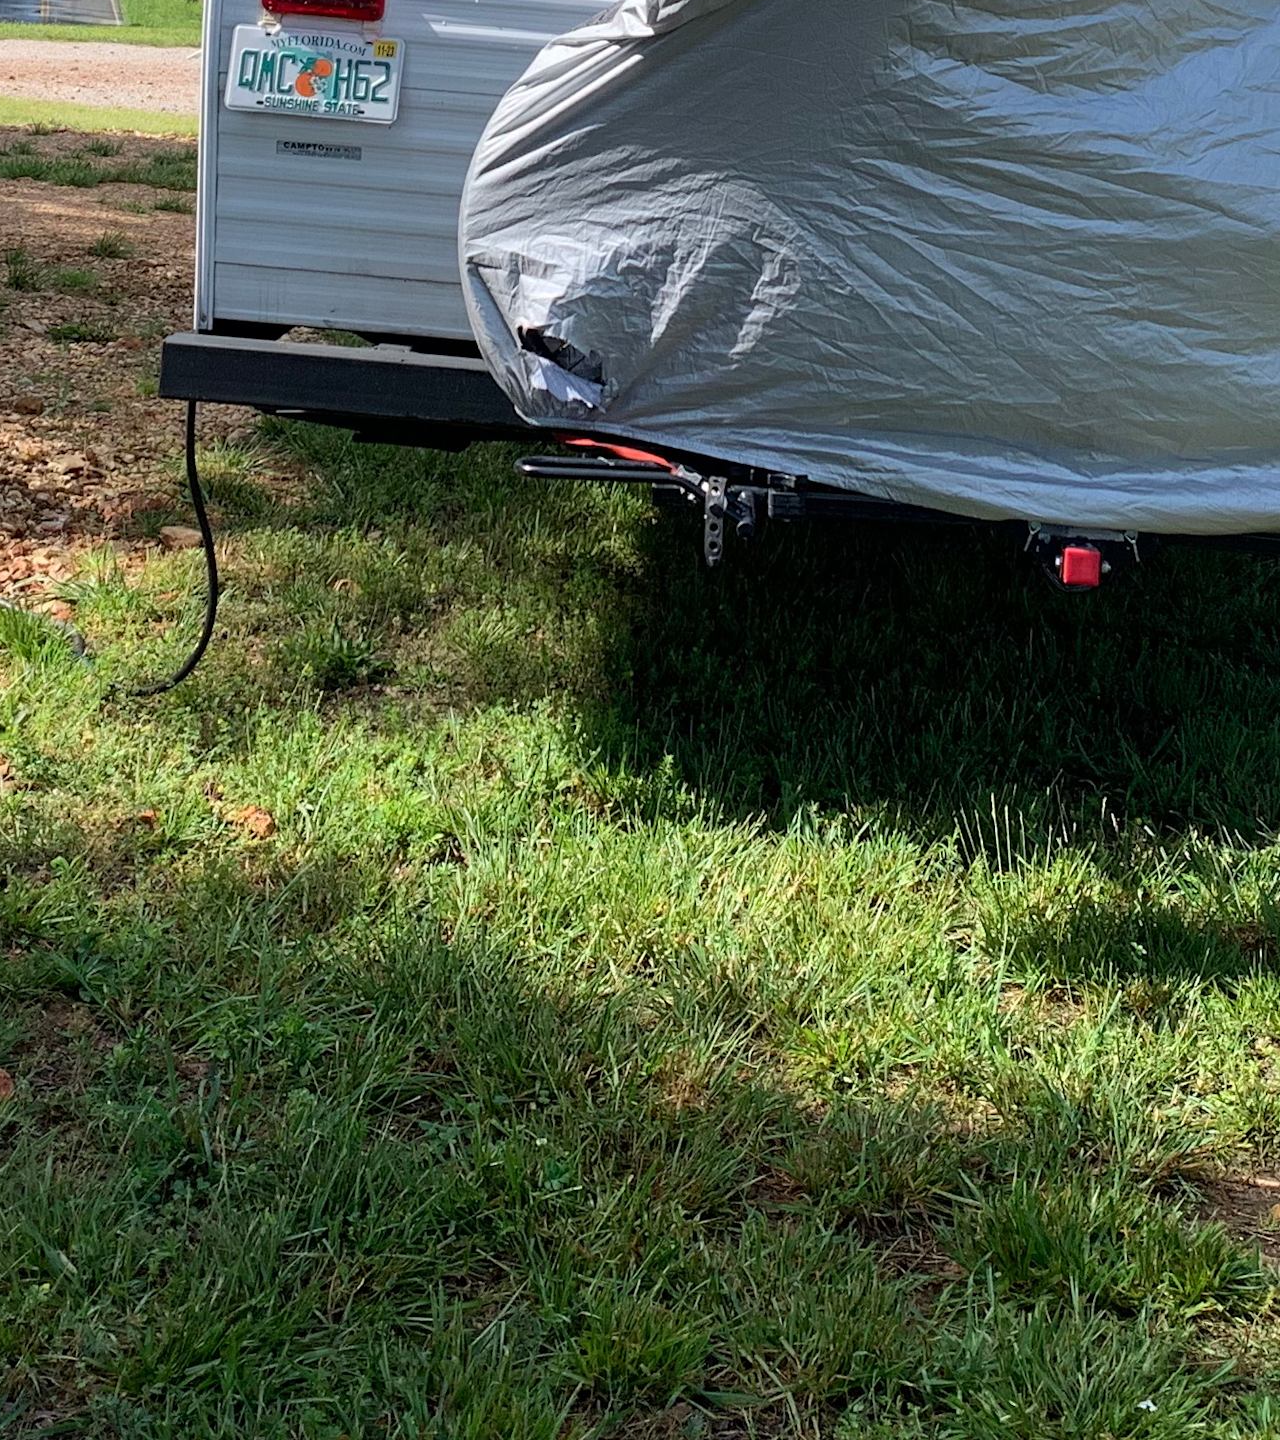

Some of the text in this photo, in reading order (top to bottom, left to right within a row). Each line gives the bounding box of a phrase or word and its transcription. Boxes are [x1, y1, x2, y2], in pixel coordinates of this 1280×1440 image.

[271, 35, 367, 57] MYFLORIDA.COM
[238, 49, 392, 103] QMC H62
[263, 96, 361, 116] SUNSHINE STATE
